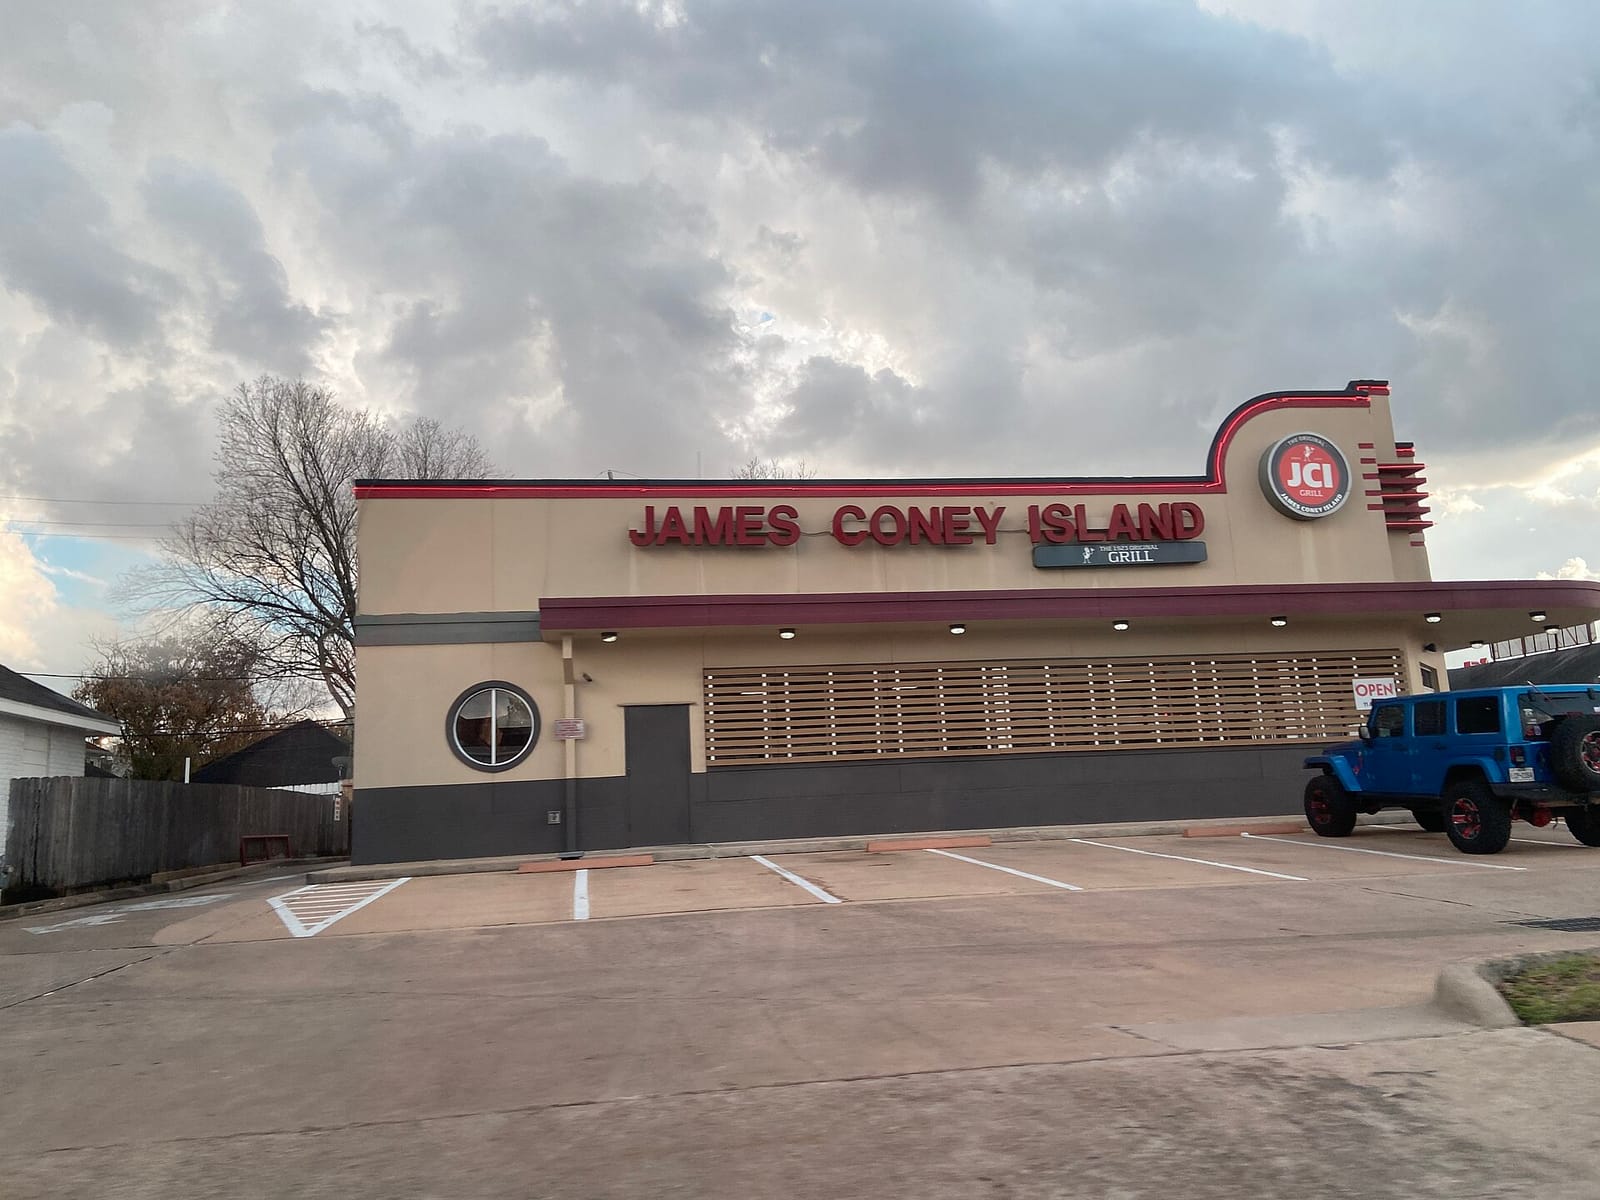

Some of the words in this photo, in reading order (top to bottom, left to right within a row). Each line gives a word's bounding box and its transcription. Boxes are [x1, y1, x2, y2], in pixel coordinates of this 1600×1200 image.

[1287, 462, 1334, 489] JCI
[1299, 489, 1324, 497] GRILL
[1281, 493, 1301, 509] JAMES
[1300, 505, 1323, 513] CONEY
[1322, 493, 1343, 511] ISLAND
[629, 505, 801, 547] JAMES
[832, 504, 1007, 546] CONEY
[1027, 502, 1205, 544] ISLAND
[1108, 551, 1154, 563] GRILL
[1355, 683, 1394, 697] OPEN
